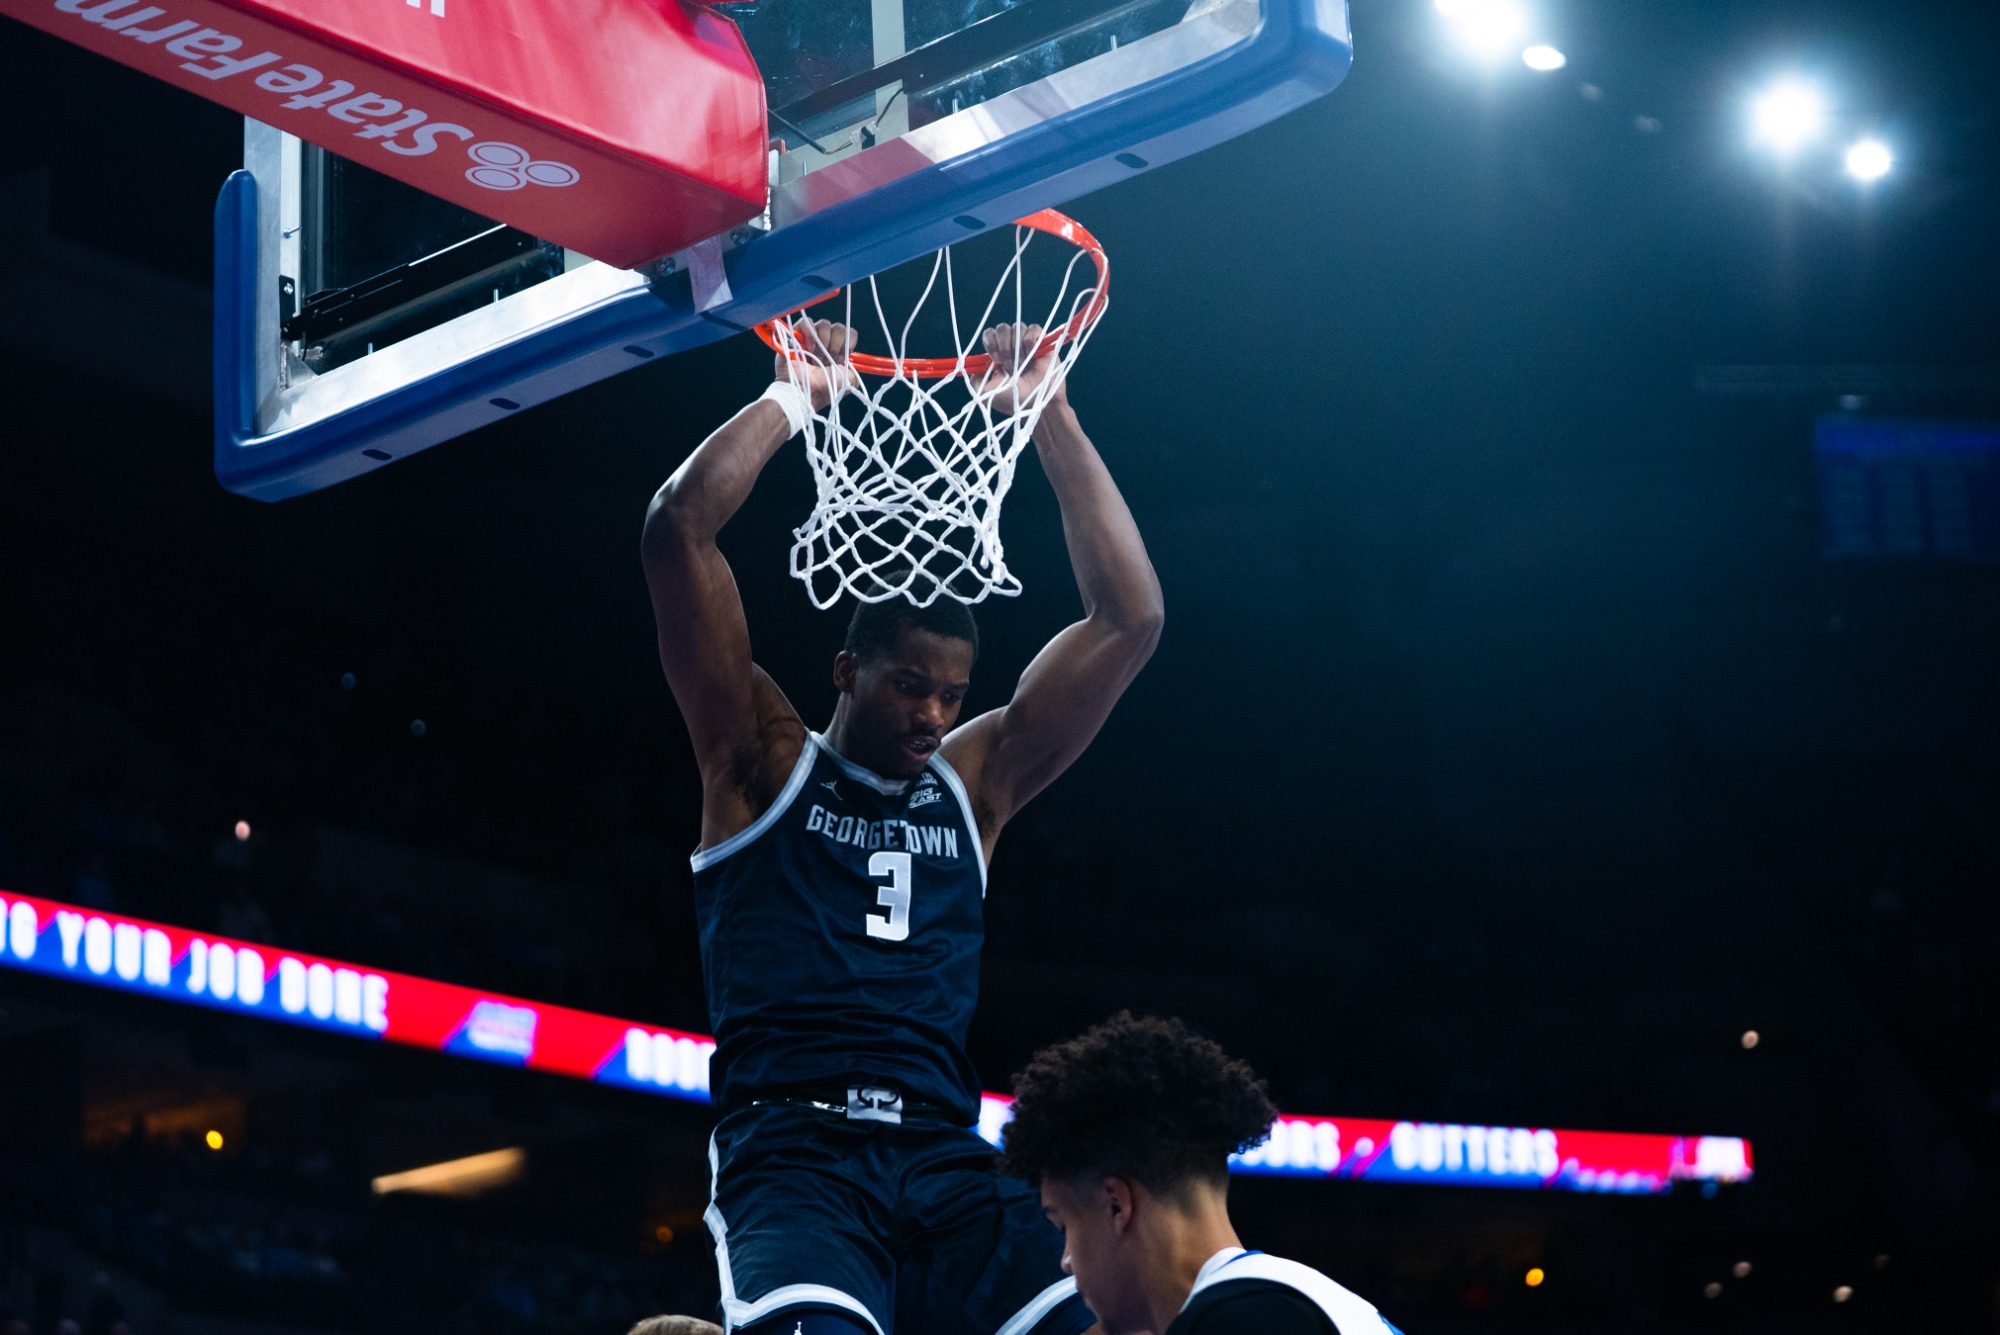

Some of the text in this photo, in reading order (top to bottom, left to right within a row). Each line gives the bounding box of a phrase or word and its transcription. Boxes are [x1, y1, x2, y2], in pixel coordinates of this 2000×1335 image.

[910, 787, 933, 800] BIG
[806, 804, 959, 859] GEORGETOWN
[866, 851, 912, 941] 3
[56, 910, 172, 987] YOUR
[186, 938, 265, 1006] JOB
[279, 956, 389, 1034] DONE
[1390, 1120, 1559, 1178] GUTTERS
